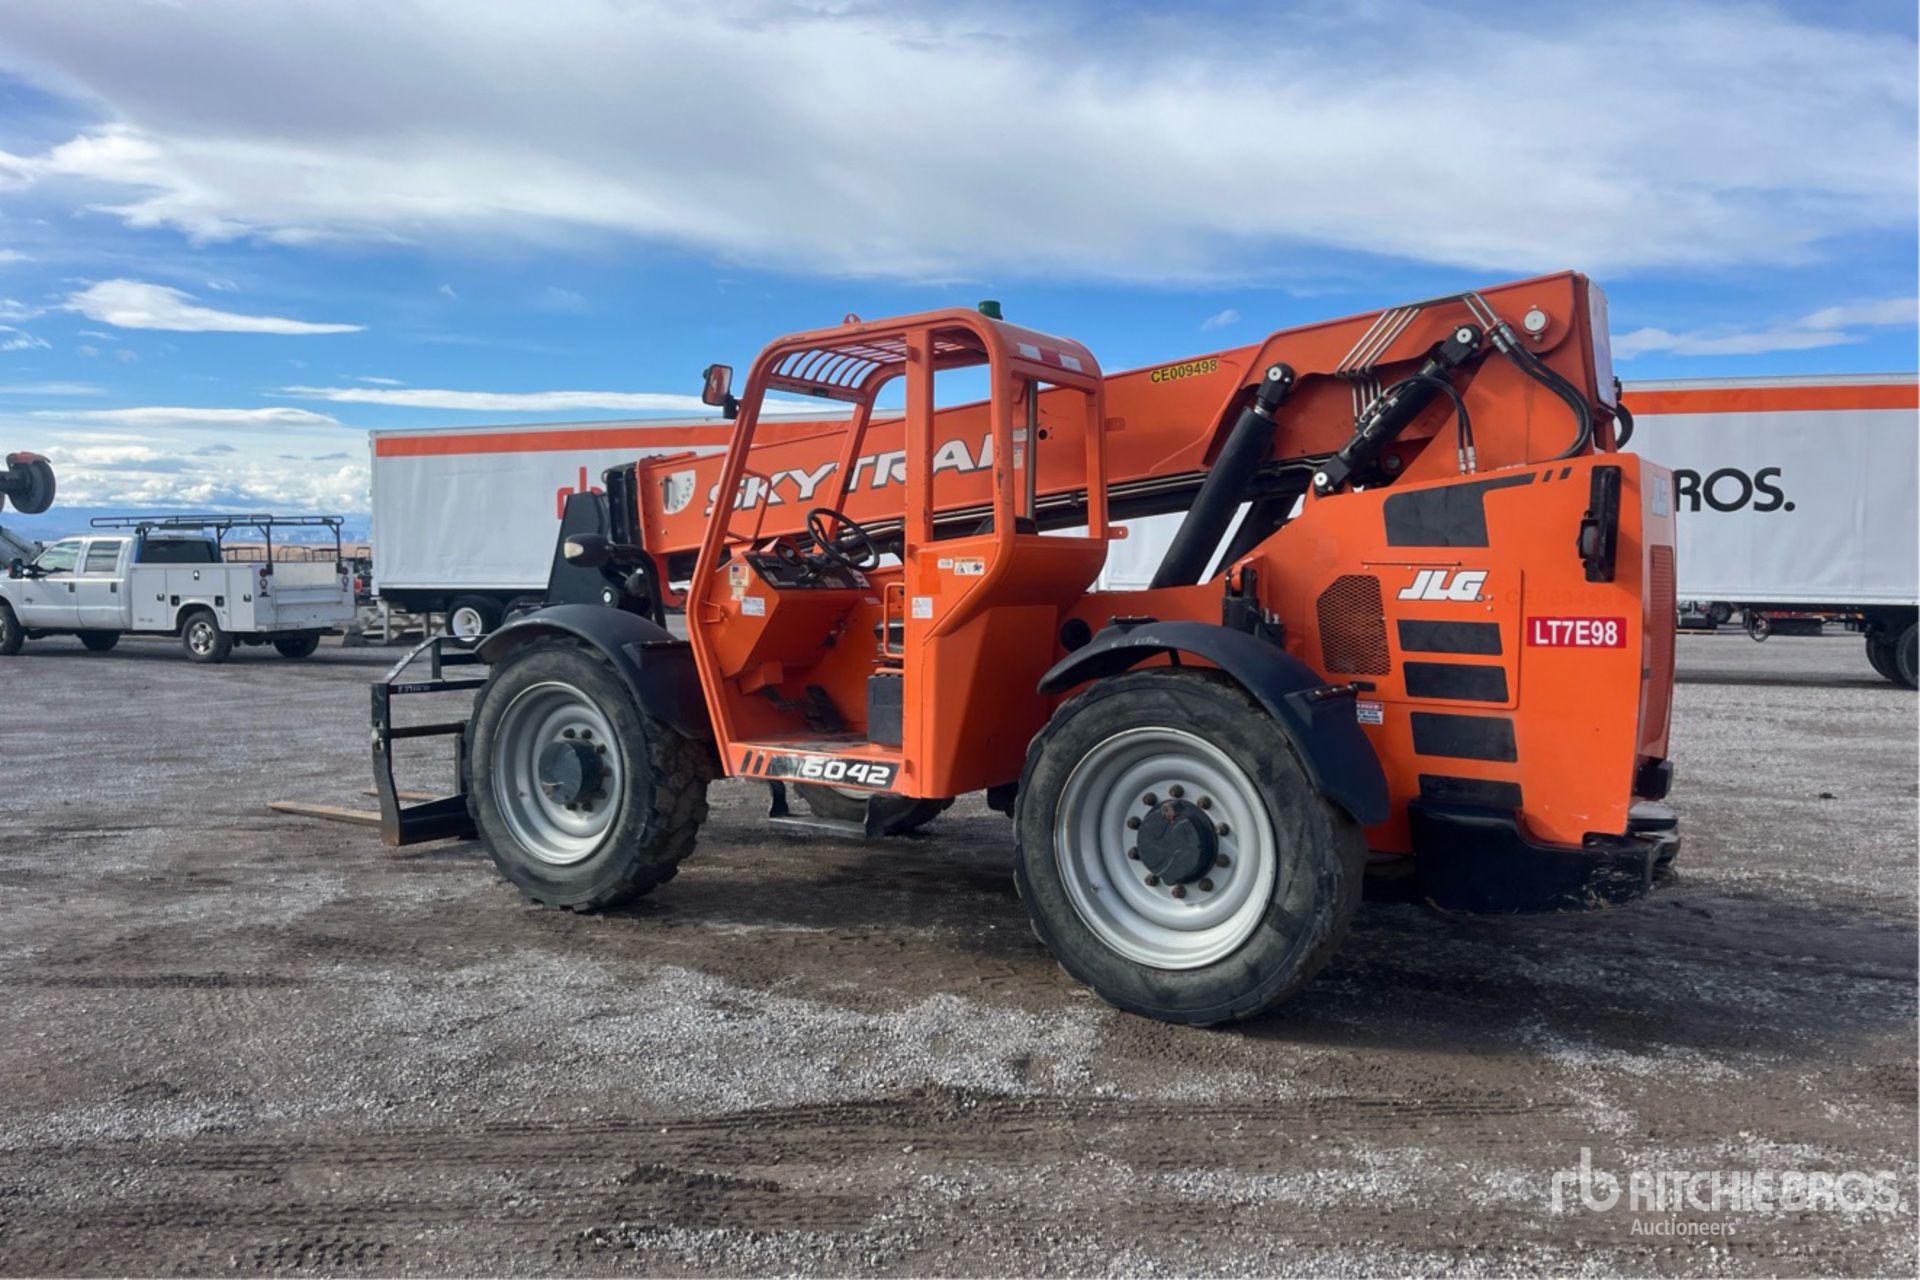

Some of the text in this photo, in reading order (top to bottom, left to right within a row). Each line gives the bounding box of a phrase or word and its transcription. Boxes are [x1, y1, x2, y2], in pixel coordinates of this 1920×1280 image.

[1151, 360, 1217, 383] CE009498
[1396, 569, 1489, 602] JLG
[1535, 620, 1618, 645] LT7E98
[802, 755, 891, 785] 6042
